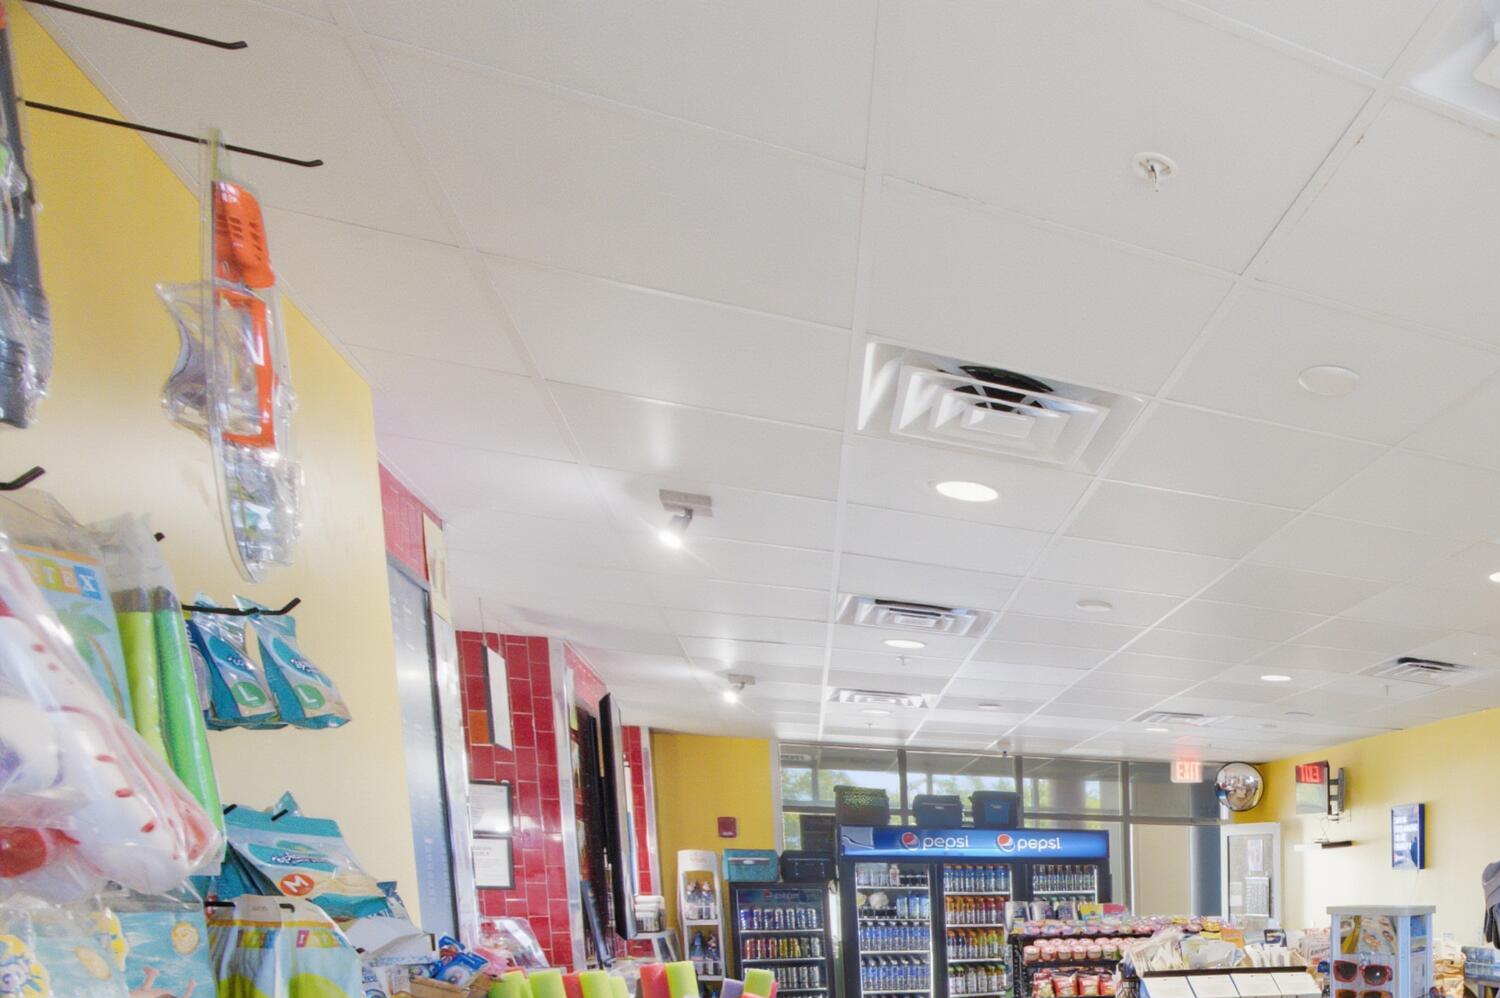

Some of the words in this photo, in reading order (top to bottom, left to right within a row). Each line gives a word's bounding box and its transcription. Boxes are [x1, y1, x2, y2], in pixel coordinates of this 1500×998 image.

[237, 685, 258, 701] L
[296, 687, 317, 702] L
[1176, 761, 1200, 782] EXIT
[922, 835, 969, 850] pepsi
[1017, 837, 1061, 852] pepsi
[282, 875, 309, 893] M
